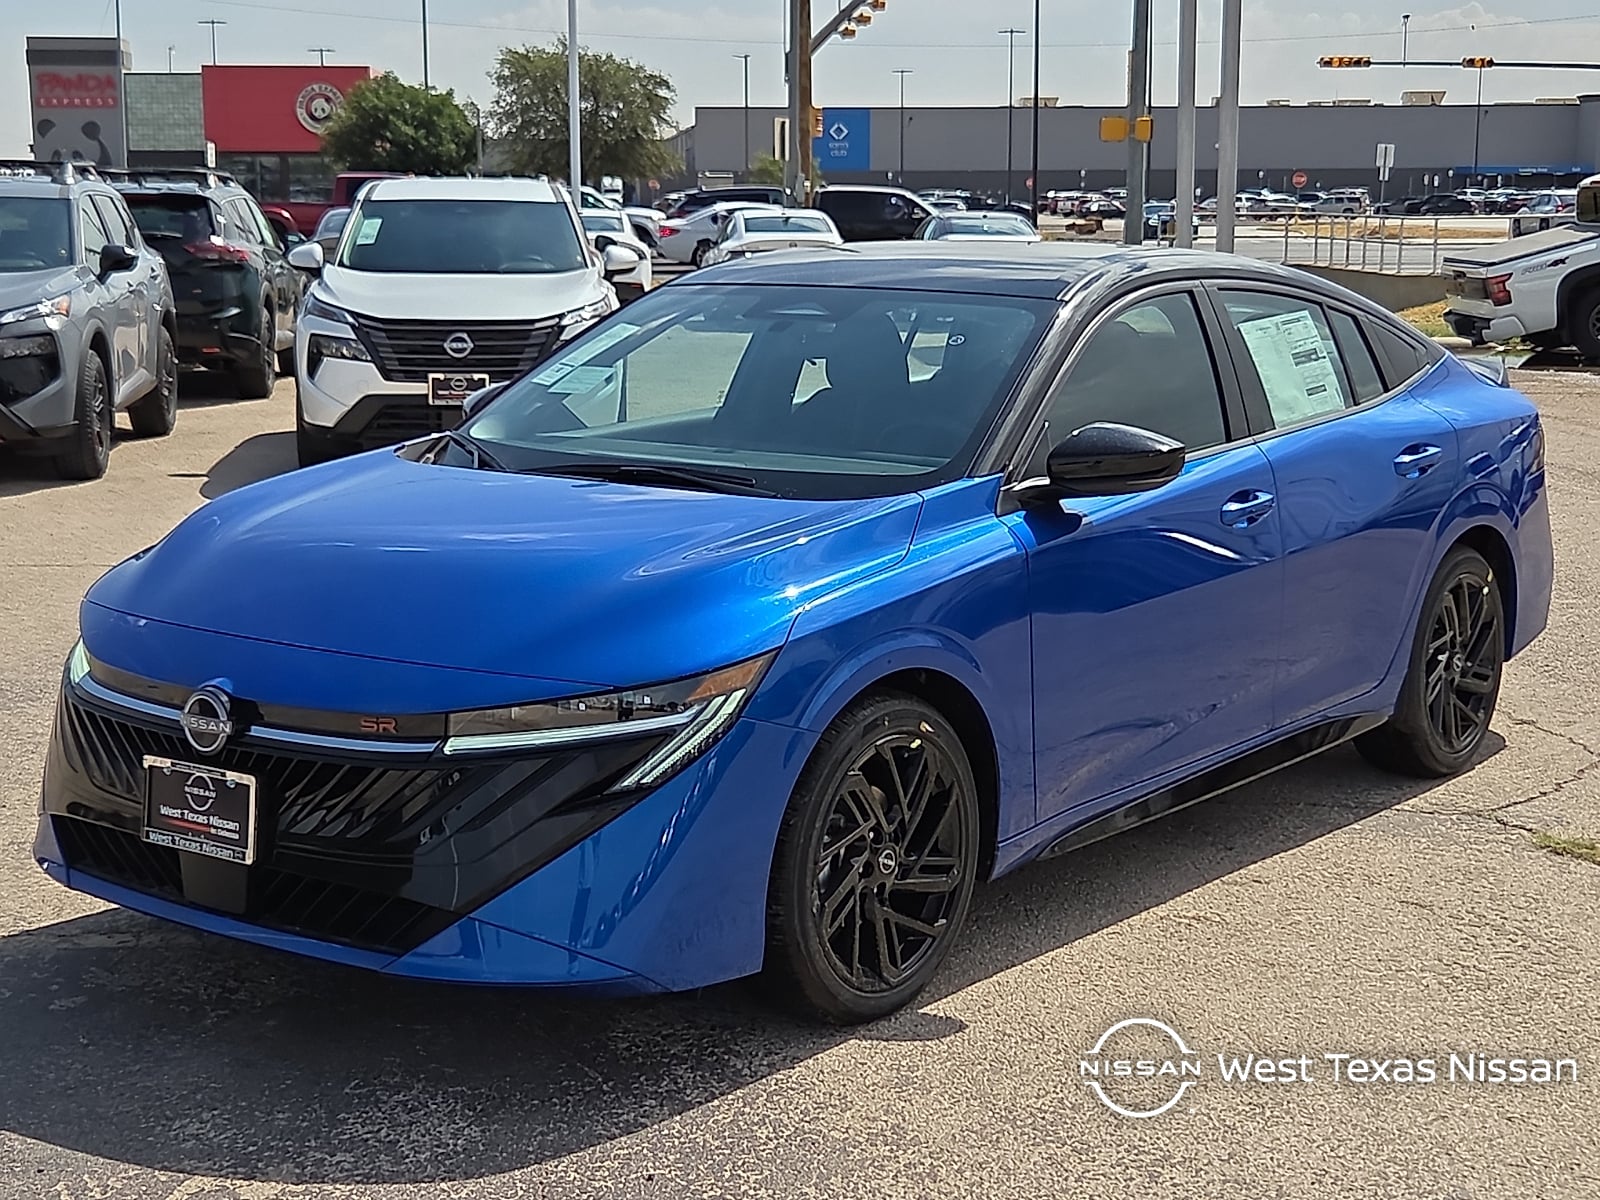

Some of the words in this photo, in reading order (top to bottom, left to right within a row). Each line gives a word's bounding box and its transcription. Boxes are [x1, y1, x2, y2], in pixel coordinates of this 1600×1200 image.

[360, 717, 397, 734] SR
[184, 785, 217, 799] NISSAN
[160, 804, 182, 819] West
[183, 809, 208, 825] Texas
[209, 815, 240, 832] Nissan
[148, 831, 173, 846] West
[173, 836, 201, 851] Texas
[202, 842, 234, 859] Nissan
